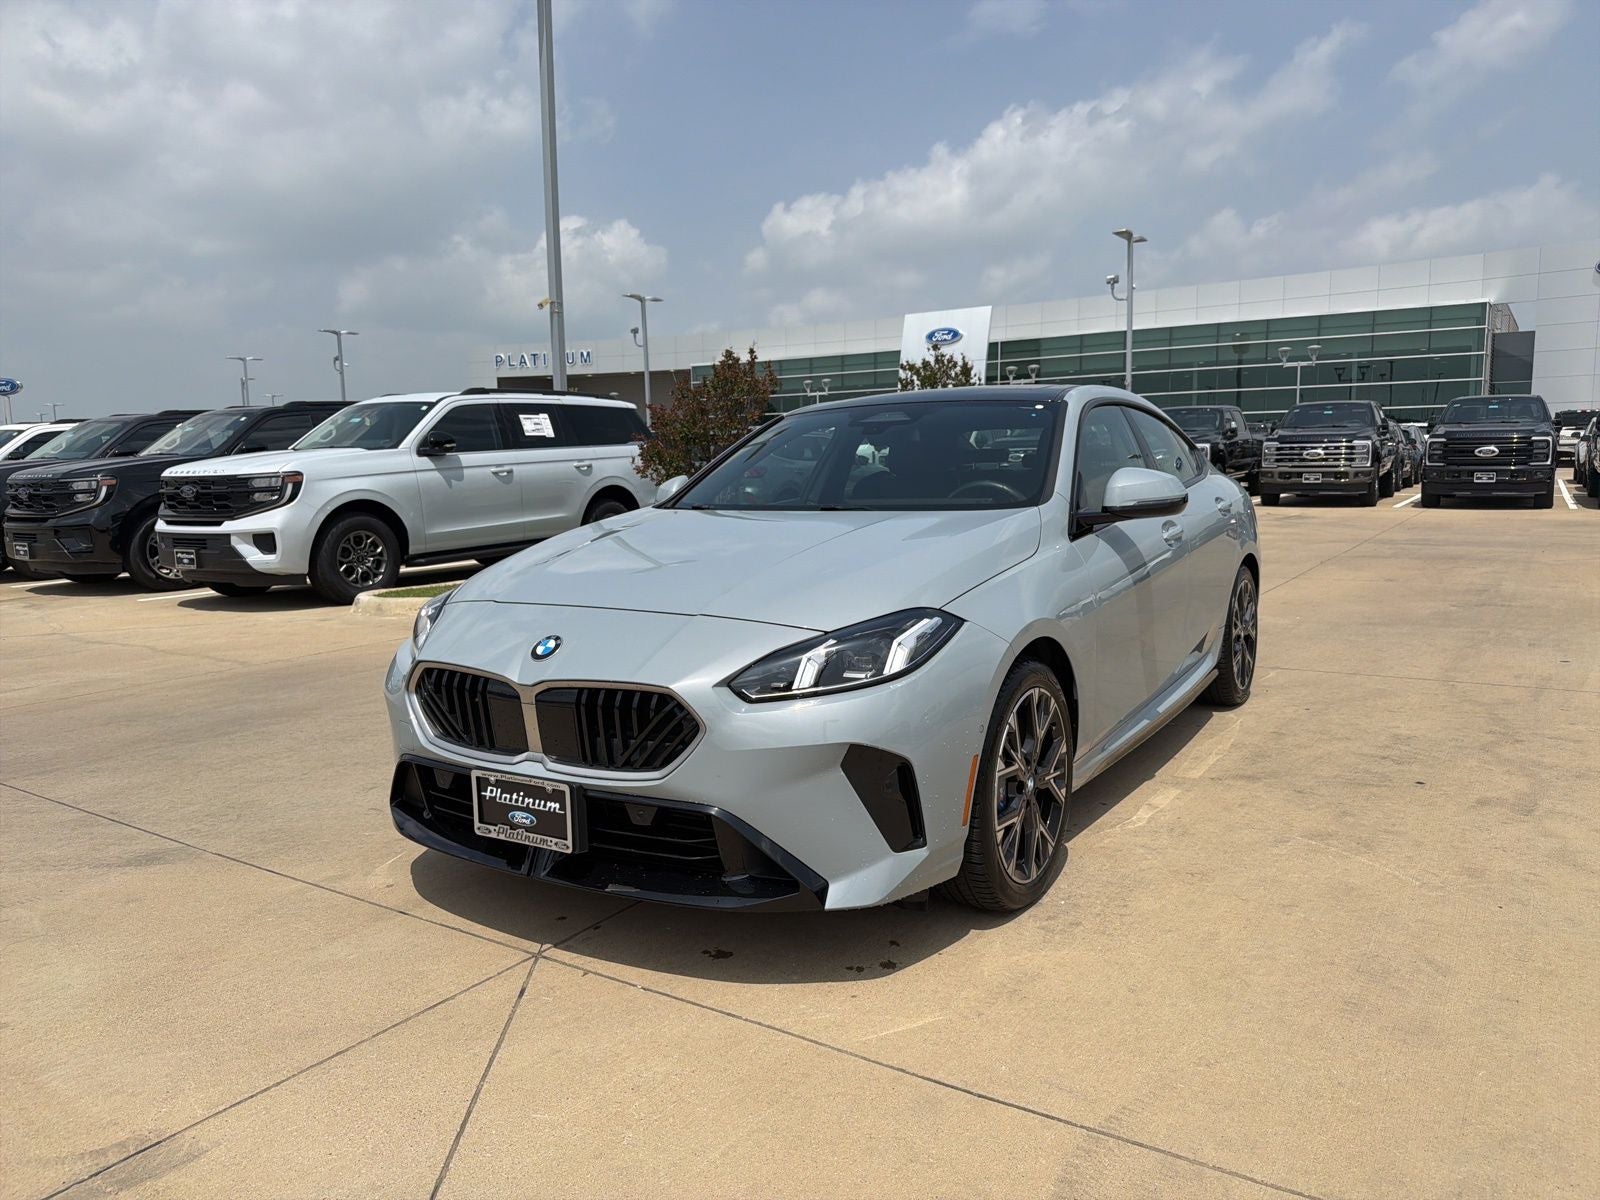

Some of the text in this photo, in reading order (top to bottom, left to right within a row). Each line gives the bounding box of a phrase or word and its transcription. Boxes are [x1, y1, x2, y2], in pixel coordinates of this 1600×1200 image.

[495, 350, 592, 368] PLATIUM
[481, 785, 565, 814] Platinum
[496, 825, 553, 849] Platinum
